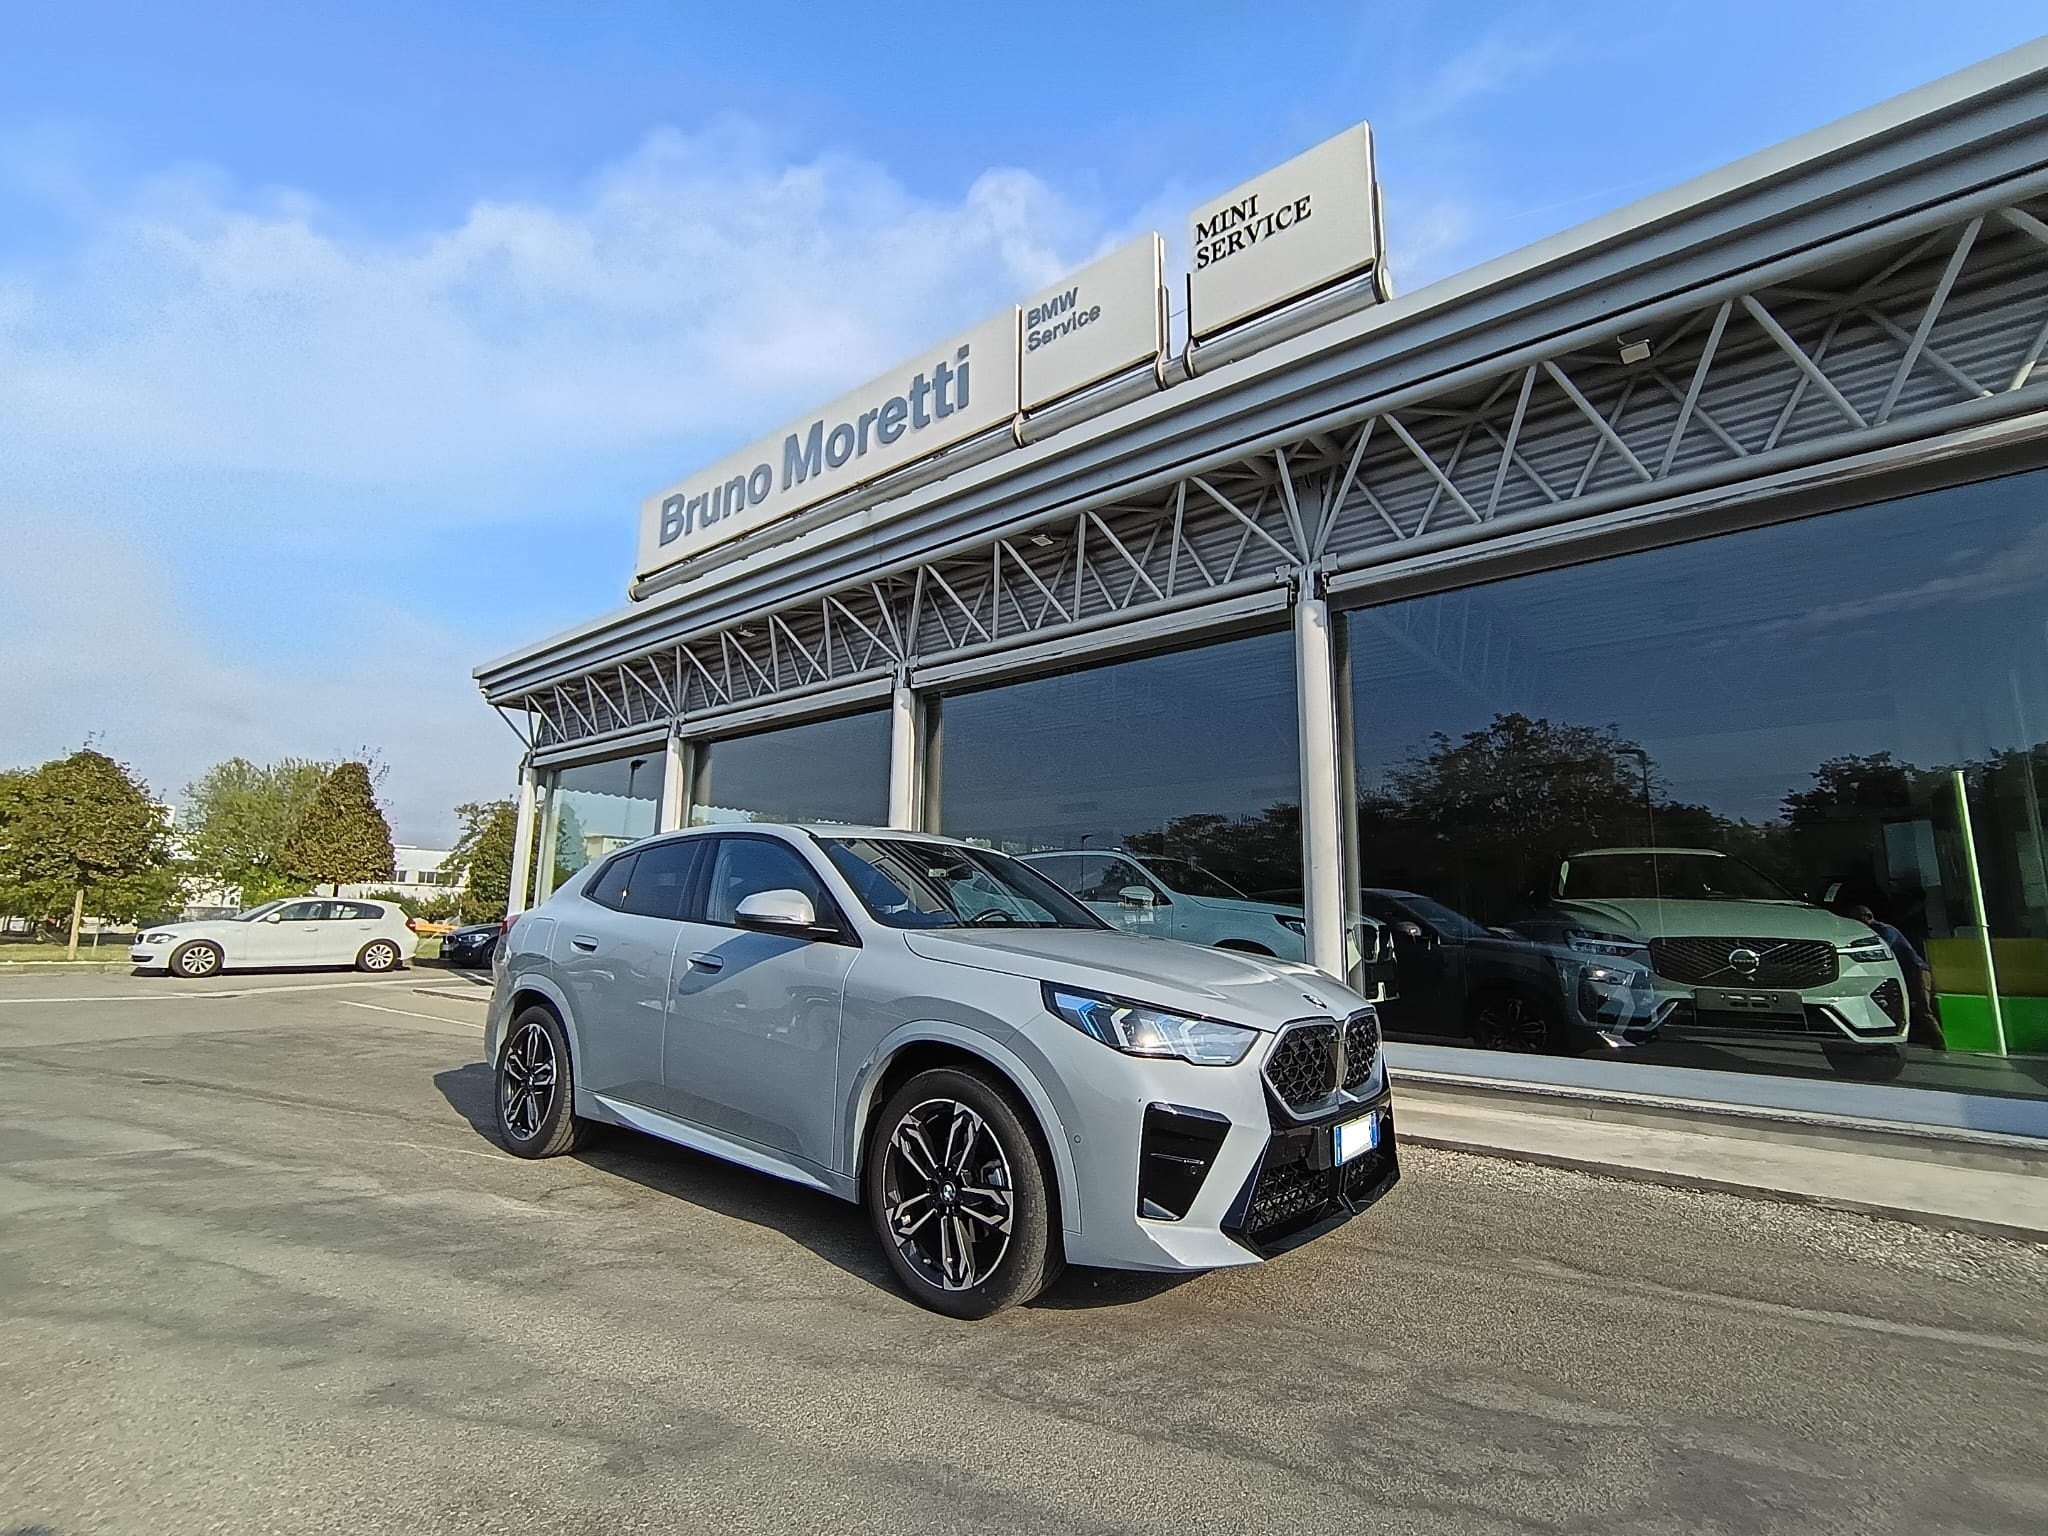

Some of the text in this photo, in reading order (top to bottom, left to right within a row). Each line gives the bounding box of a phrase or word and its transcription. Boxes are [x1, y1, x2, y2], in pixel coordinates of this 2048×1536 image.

[1194, 194, 1259, 246] MINI
[1196, 194, 1312, 270] SERVICE
[1027, 286, 1078, 330] BMW
[1027, 305, 1101, 352] Service
[659, 343, 970, 547] Bruno Moretti
